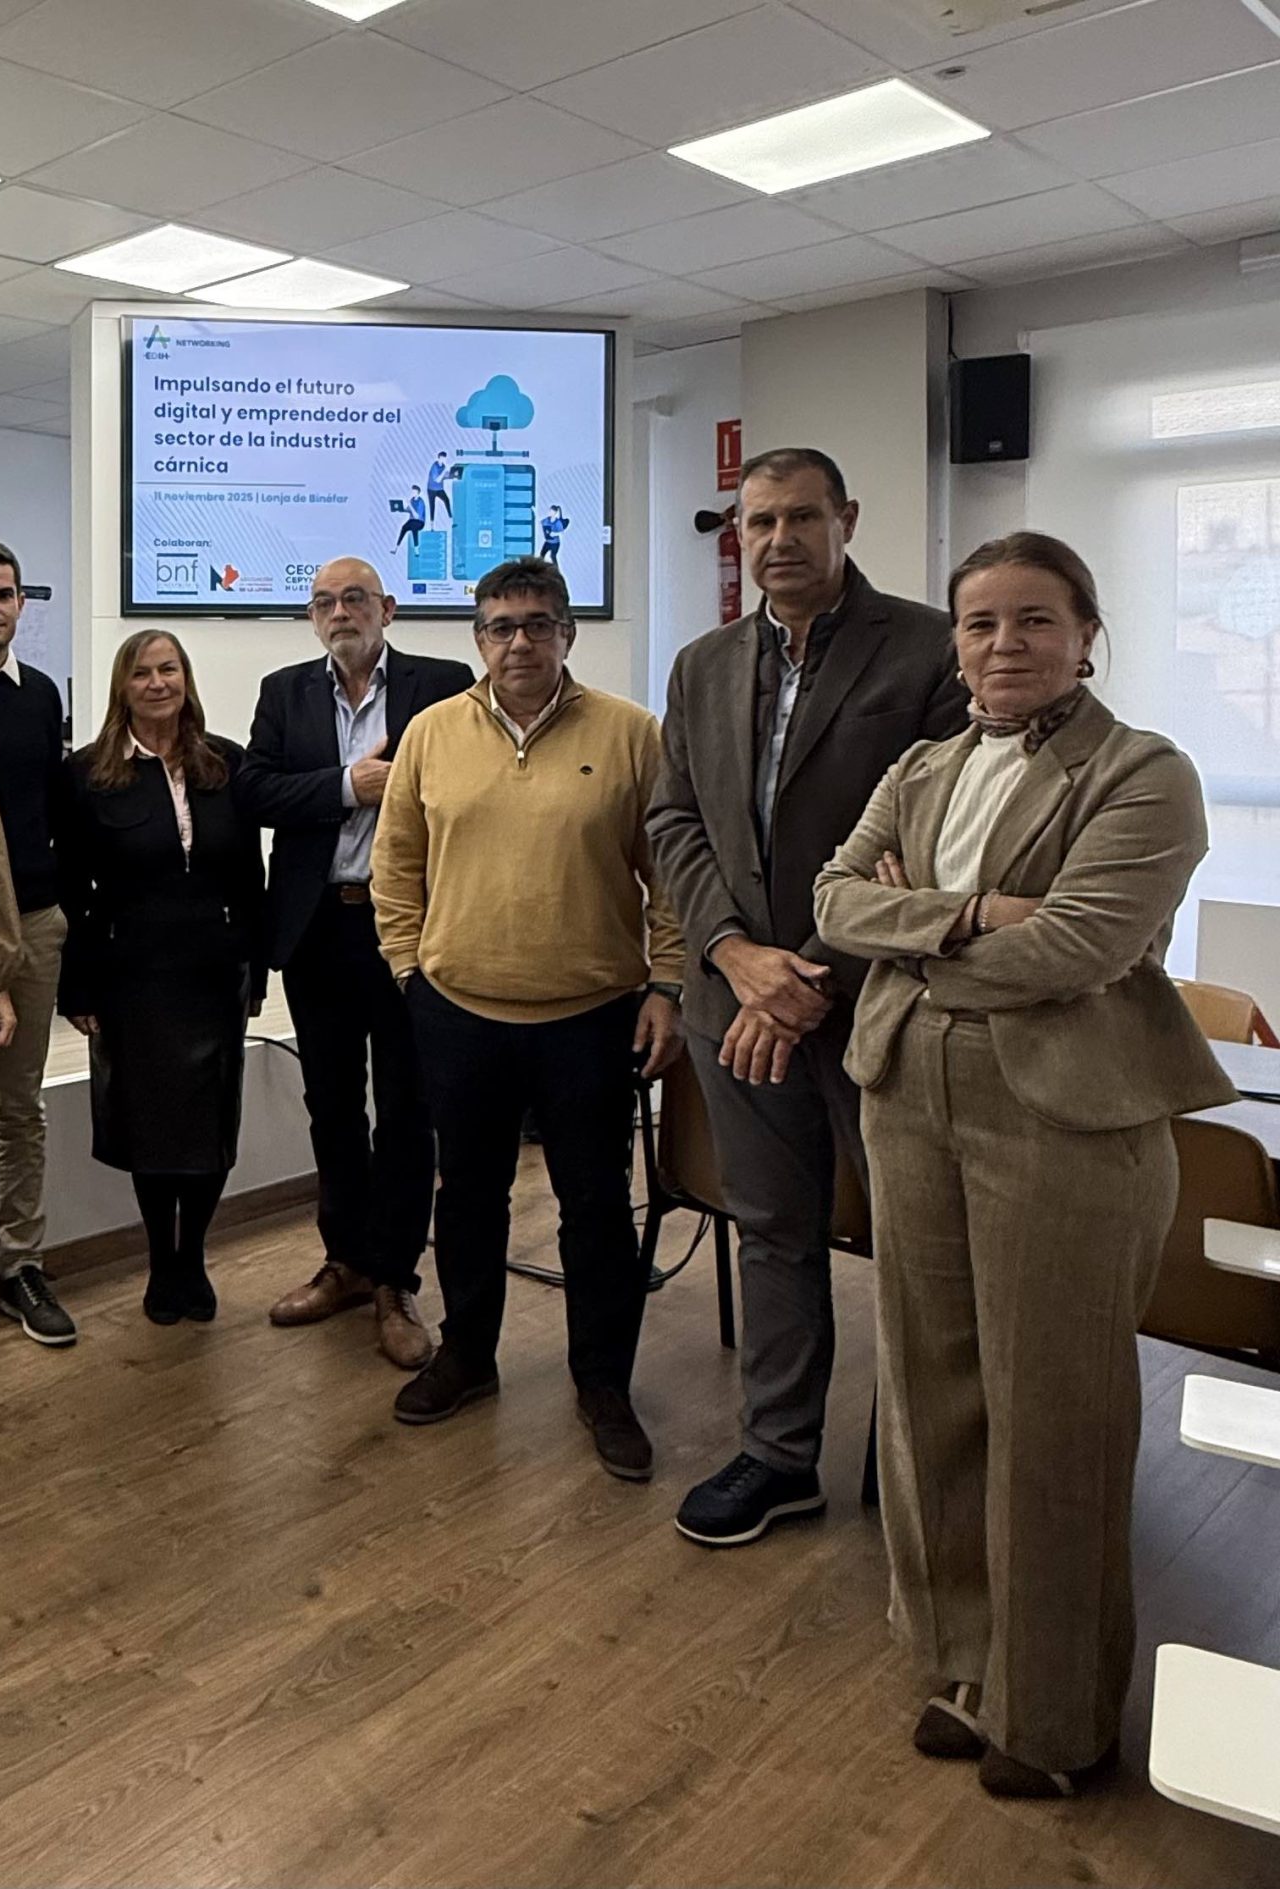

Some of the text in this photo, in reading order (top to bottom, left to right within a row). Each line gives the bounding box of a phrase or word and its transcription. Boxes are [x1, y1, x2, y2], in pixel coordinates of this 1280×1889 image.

[176, 339, 231, 348] NETWORKING
[154, 376, 355, 396] Impulsando el futuro
[154, 403, 401, 425] digital y emprendedor del
[154, 431, 356, 449] sector de la industria
[154, 456, 229, 473] cárnica
[164, 491, 225, 502] noviembre
[227, 492, 253, 502] 2025
[261, 493, 291, 505] Lonja
[293, 494, 307, 503] de
[309, 494, 349, 504] Binéfar
[157, 559, 199, 583] bnf
